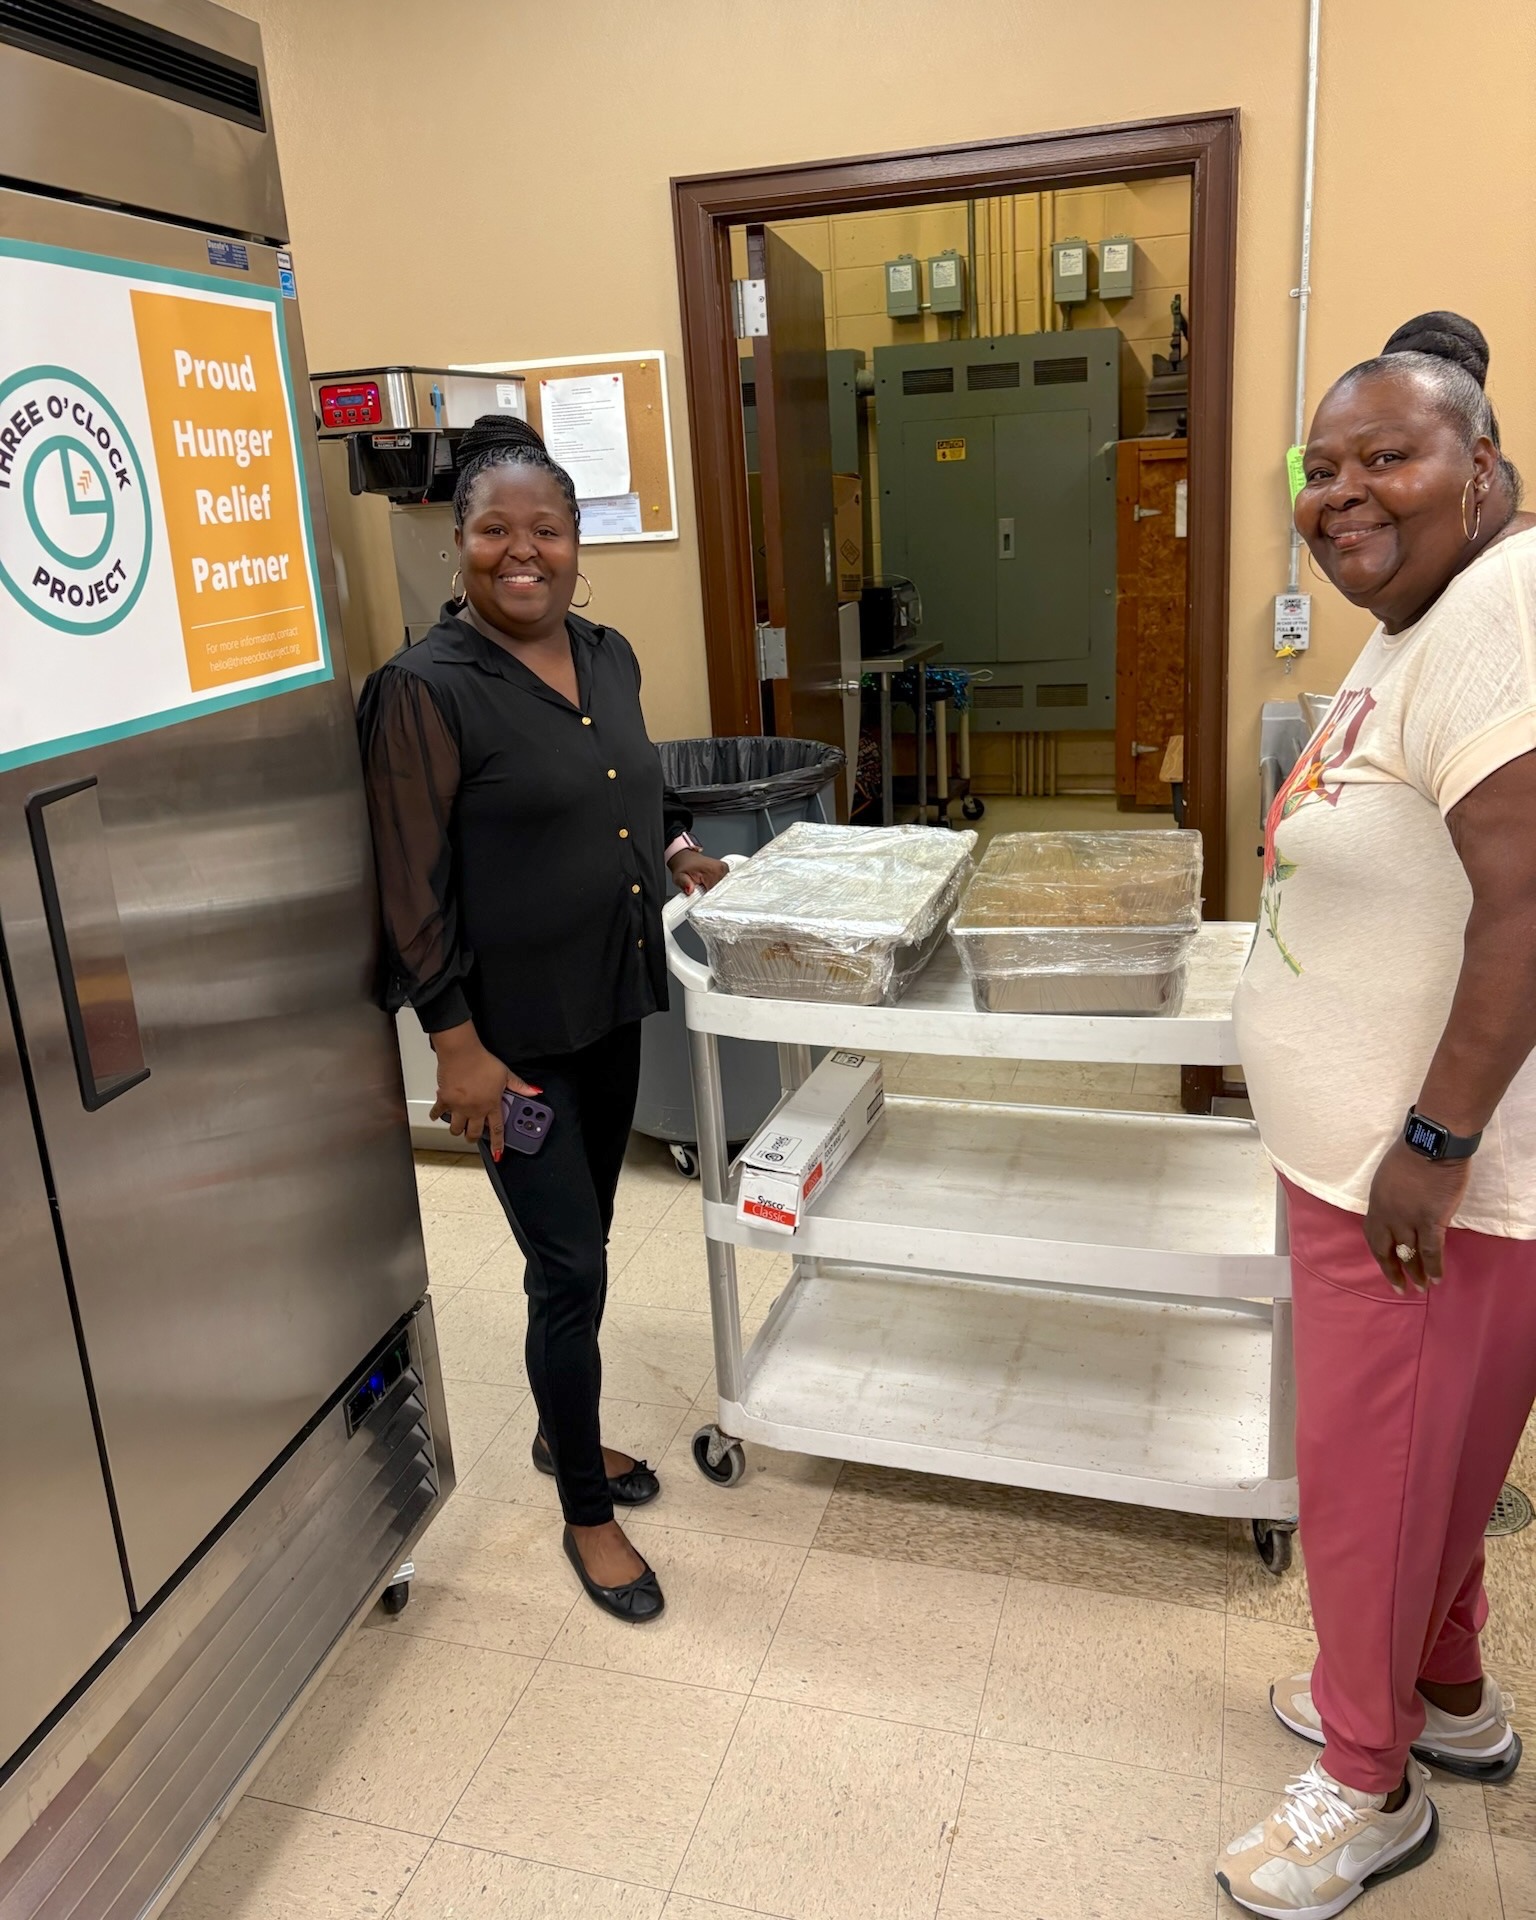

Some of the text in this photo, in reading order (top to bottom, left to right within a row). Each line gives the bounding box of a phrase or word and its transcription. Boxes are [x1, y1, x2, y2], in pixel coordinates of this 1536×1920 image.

[174, 349, 257, 392] Proud
[173, 420, 273, 468] Hunger
[938, 440, 964, 449] CAUTION
[195, 484, 271, 525] Relief
[32, 558, 127, 608] PROJECT
[191, 553, 289, 593] Partner
[206, 643, 219, 655] For
[219, 640, 239, 652] more
[277, 627, 299, 640] contact
[752, 1204, 787, 1224] Classic
[757, 1195, 785, 1211] Sysco
